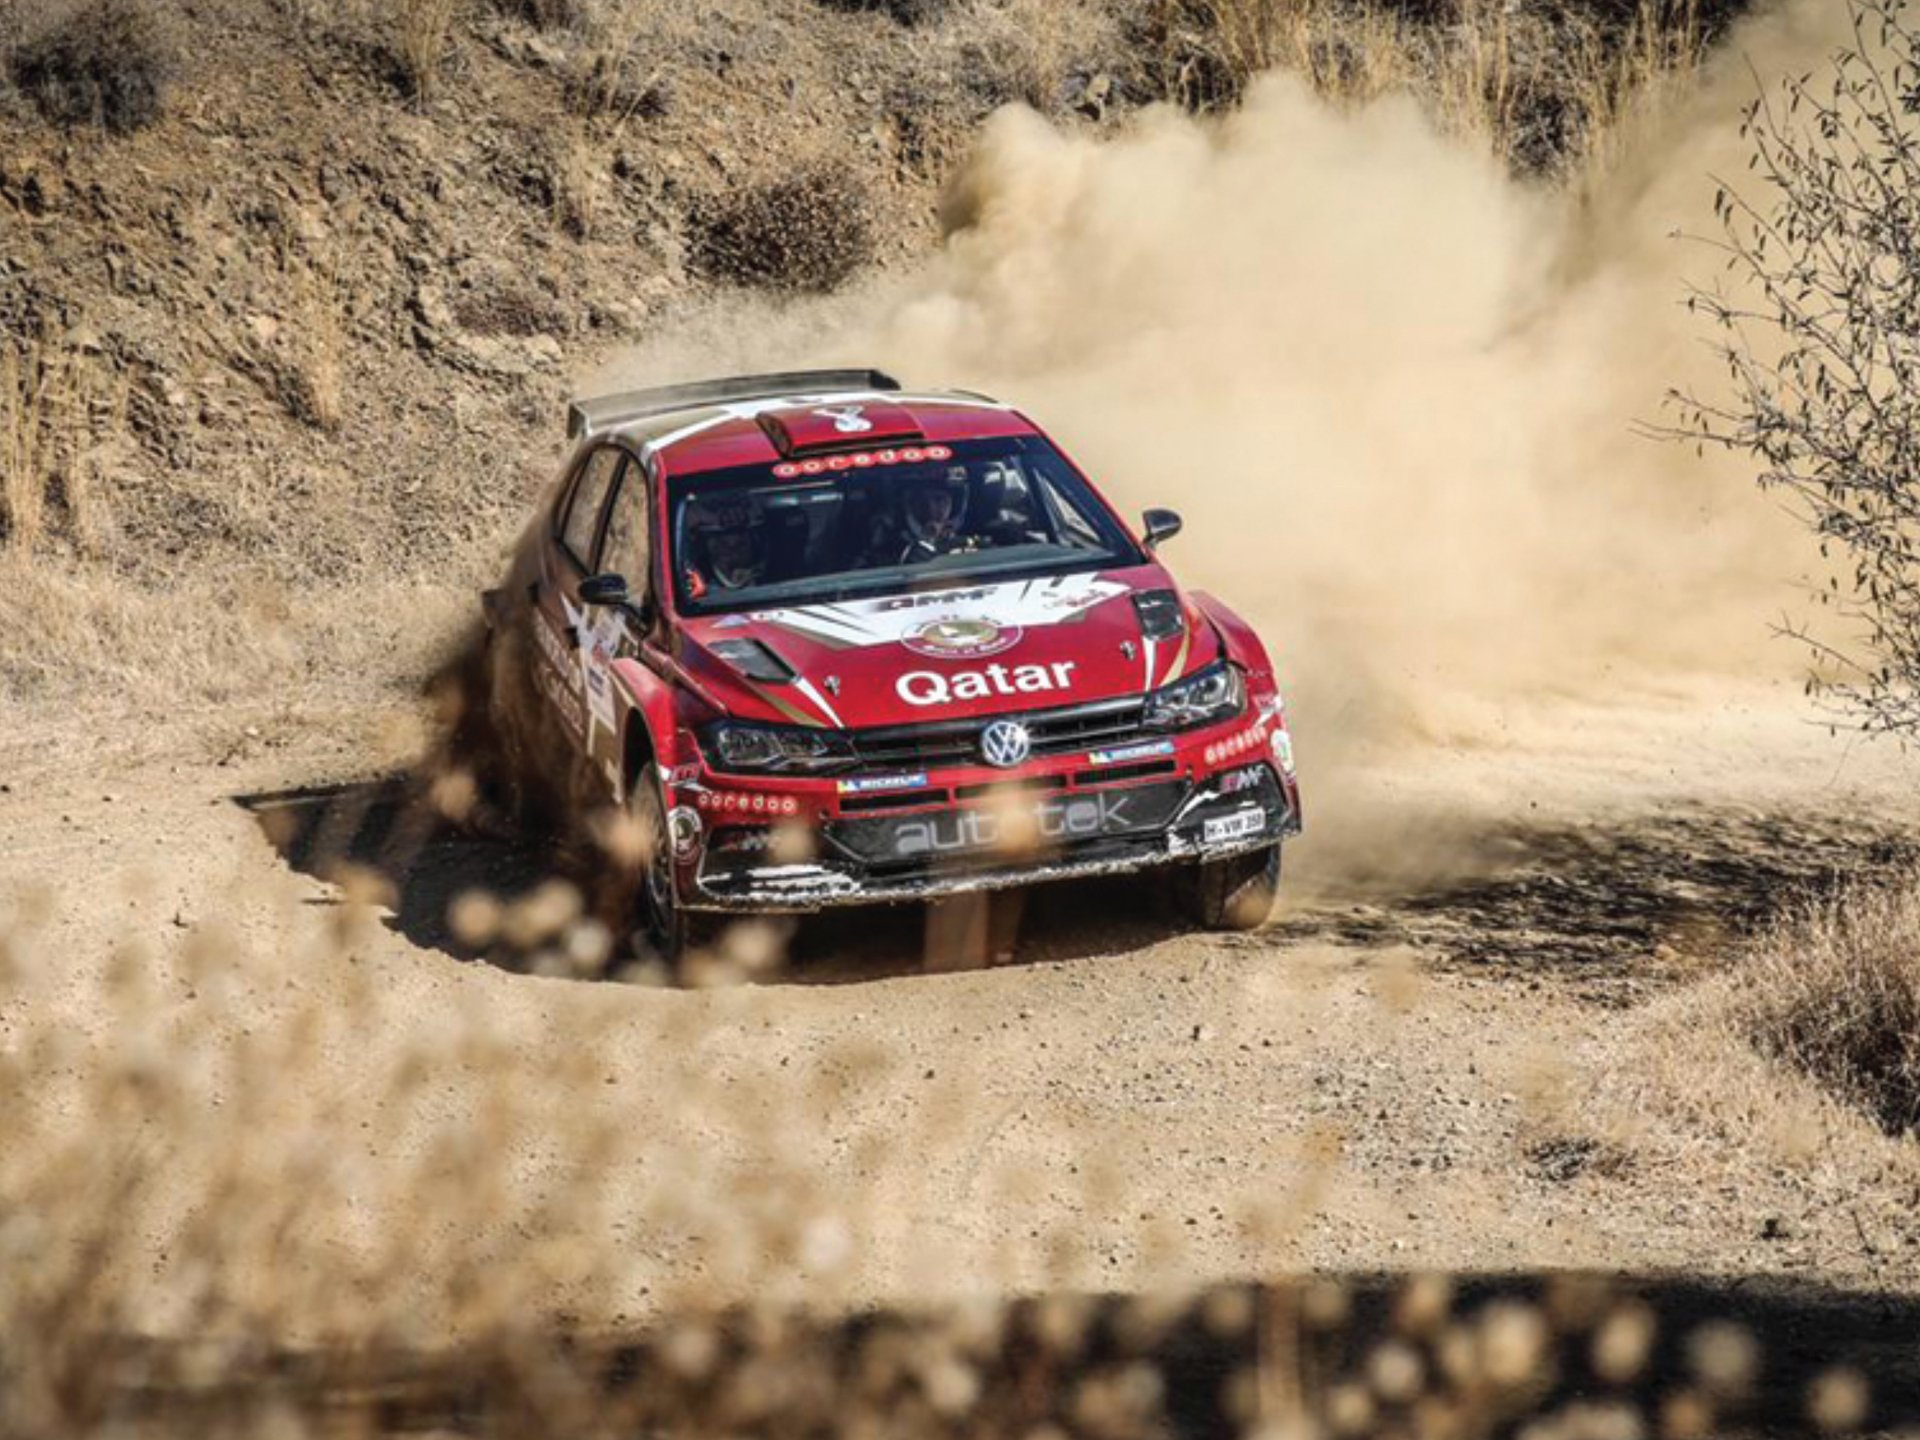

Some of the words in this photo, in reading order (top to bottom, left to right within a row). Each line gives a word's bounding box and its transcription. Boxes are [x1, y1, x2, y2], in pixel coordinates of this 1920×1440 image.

[774, 447, 951, 478] ooredoo
[896, 661, 1075, 705] Qatar
[698, 792, 798, 813] ooredoo
[896, 793, 1131, 855] auttek
